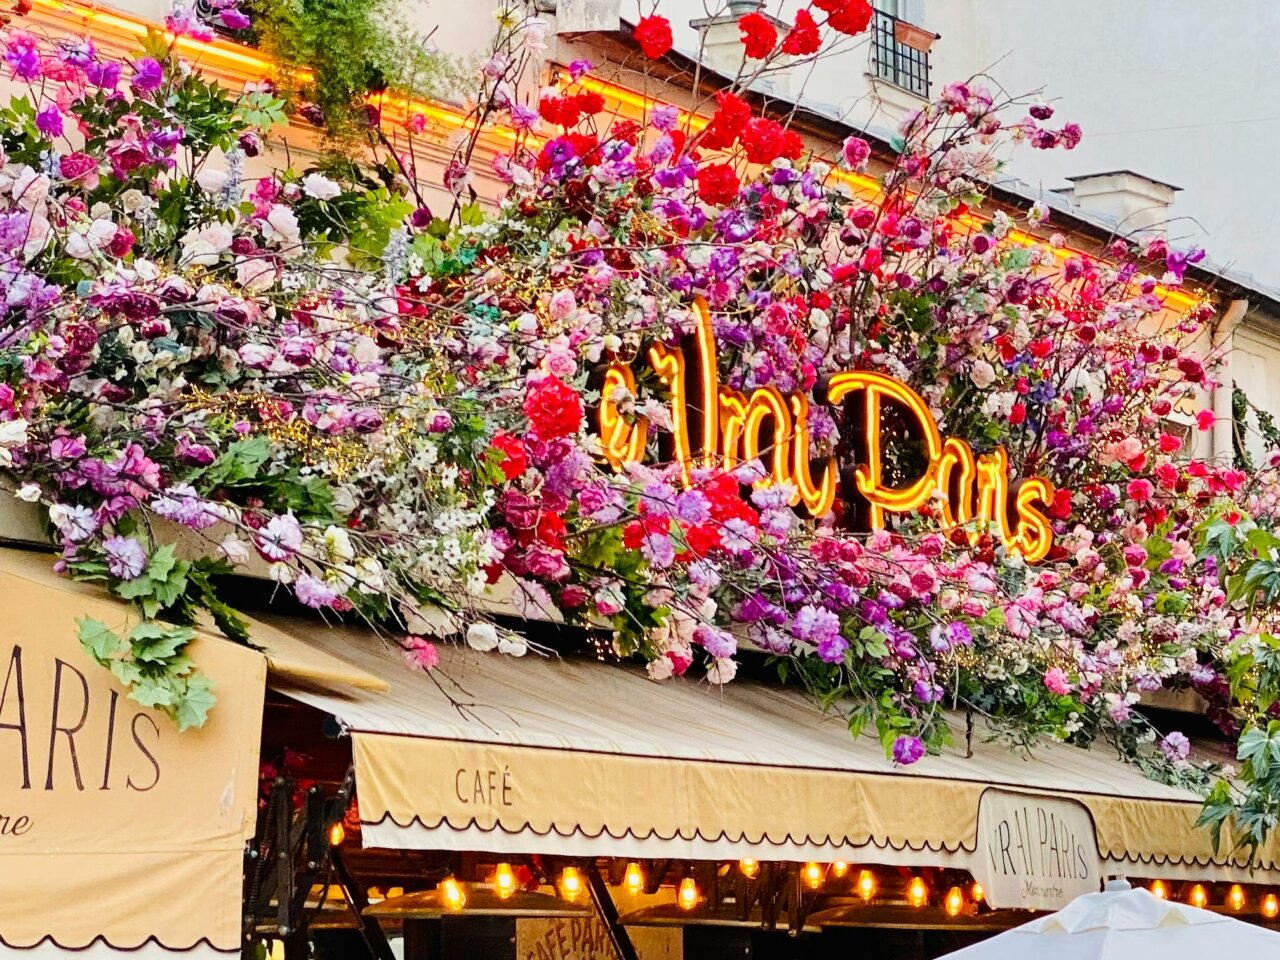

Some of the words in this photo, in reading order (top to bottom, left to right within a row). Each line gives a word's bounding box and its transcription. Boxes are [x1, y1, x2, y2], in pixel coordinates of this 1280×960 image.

[455, 765, 512, 806] CAFÉ
[988, 807, 1034, 876] VRAI
[1036, 807, 1088, 879] PARIS
